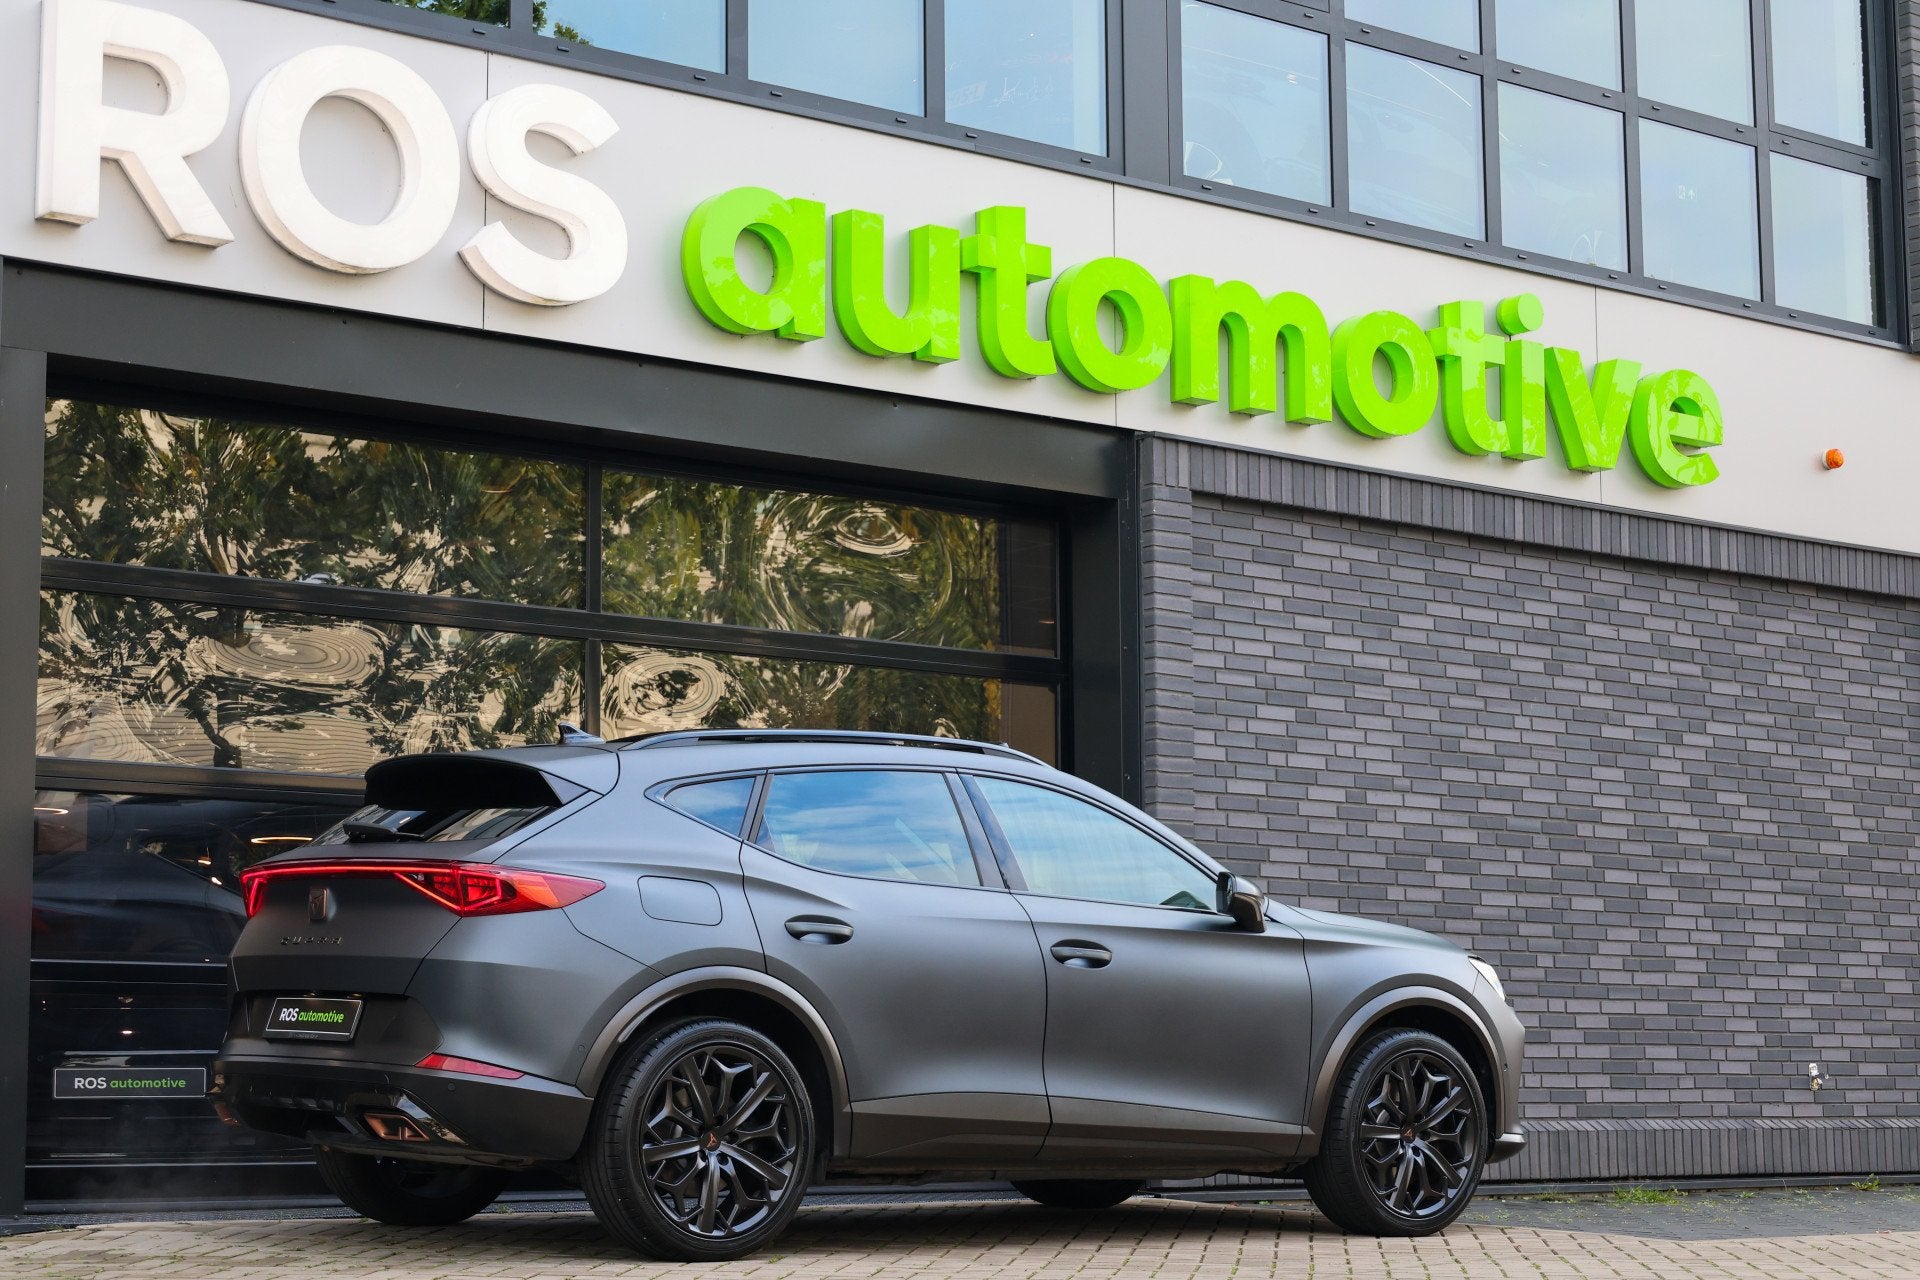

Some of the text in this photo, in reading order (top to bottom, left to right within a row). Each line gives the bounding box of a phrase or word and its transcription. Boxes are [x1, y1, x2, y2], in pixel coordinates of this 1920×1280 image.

[35, 0, 1724, 491] ROS automotive
[279, 1008, 344, 1023] ROS automotive
[74, 1077, 186, 1089] ROS automotive
